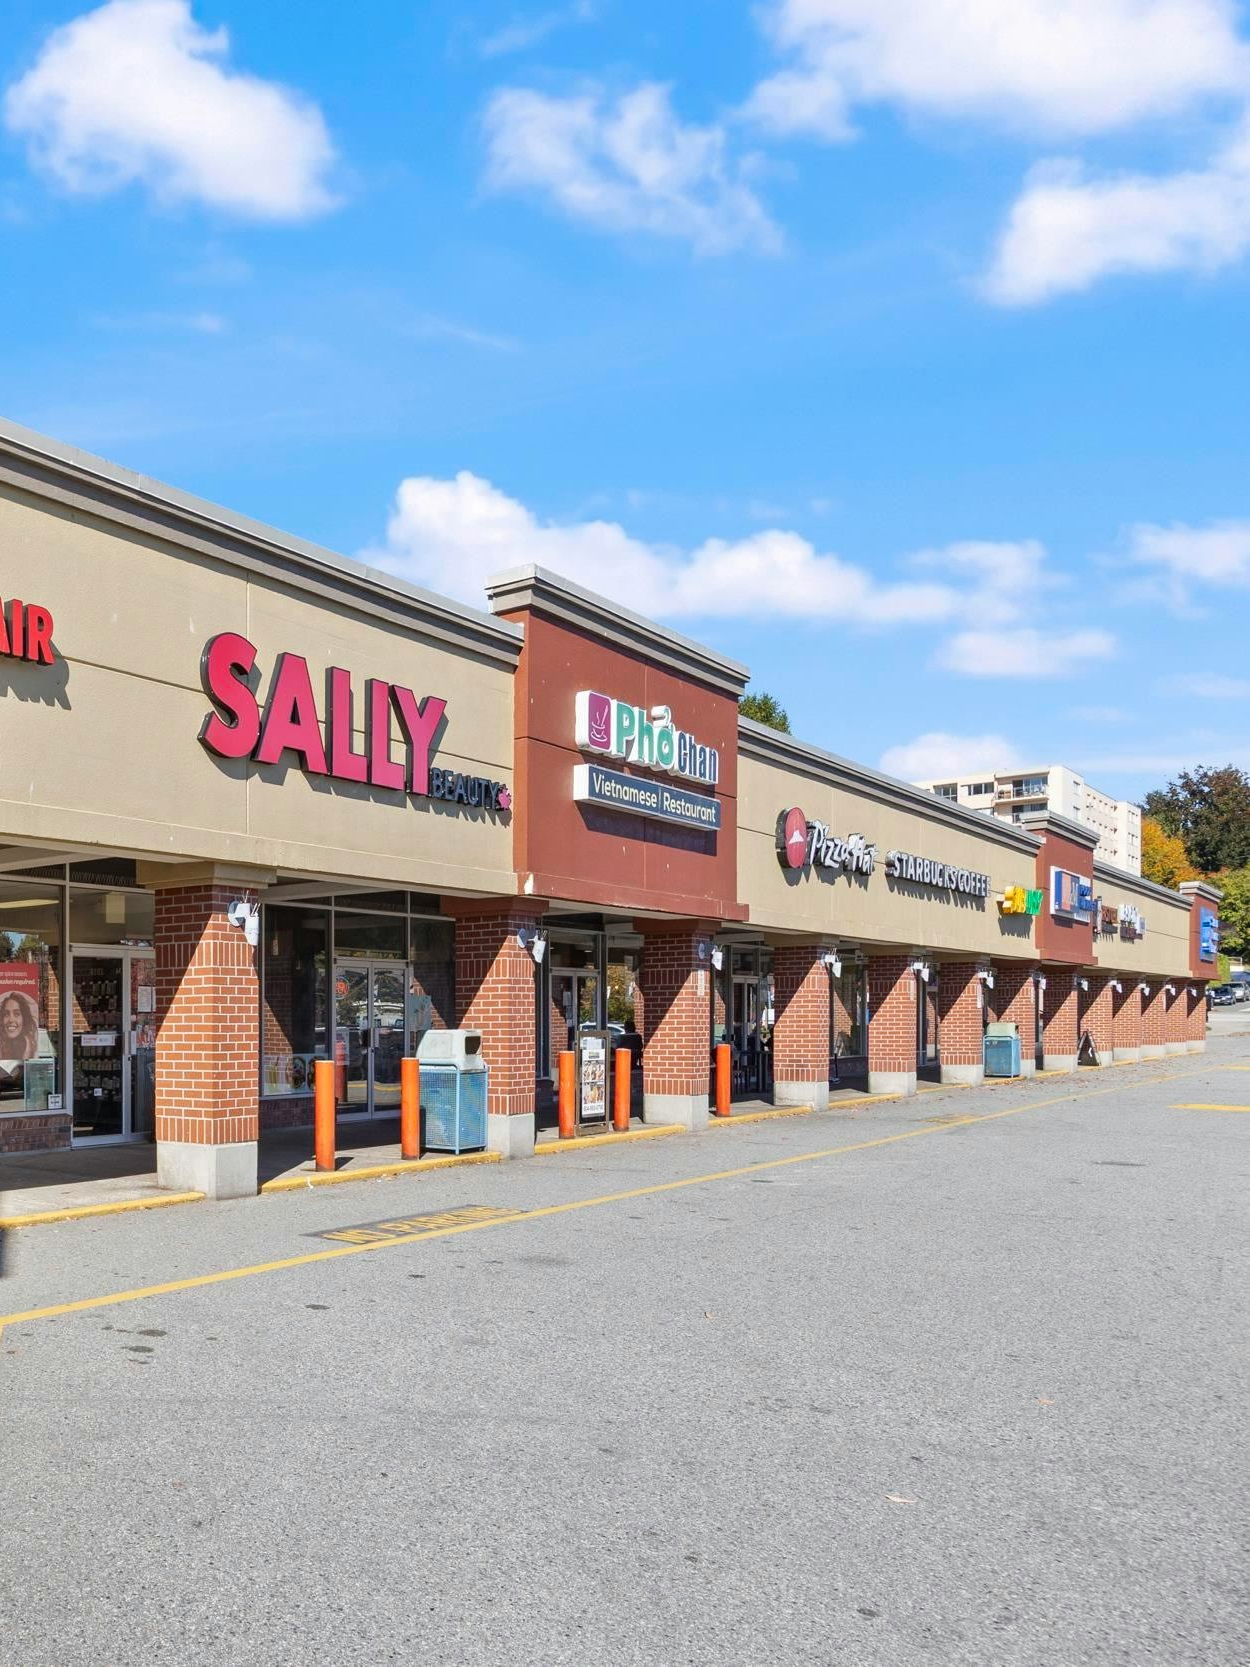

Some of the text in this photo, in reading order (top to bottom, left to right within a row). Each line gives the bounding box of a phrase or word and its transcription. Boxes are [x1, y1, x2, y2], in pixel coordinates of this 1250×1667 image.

[197, 632, 447, 795] SALLY
[677, 731, 719, 784] Chan
[431, 767, 499, 810] BEAUTY
[592, 772, 716, 823] Vietnamese Restaurant
[808, 819, 878, 875] Pizza Hut
[892, 852, 991, 897] STARBUCKS COFFEE
